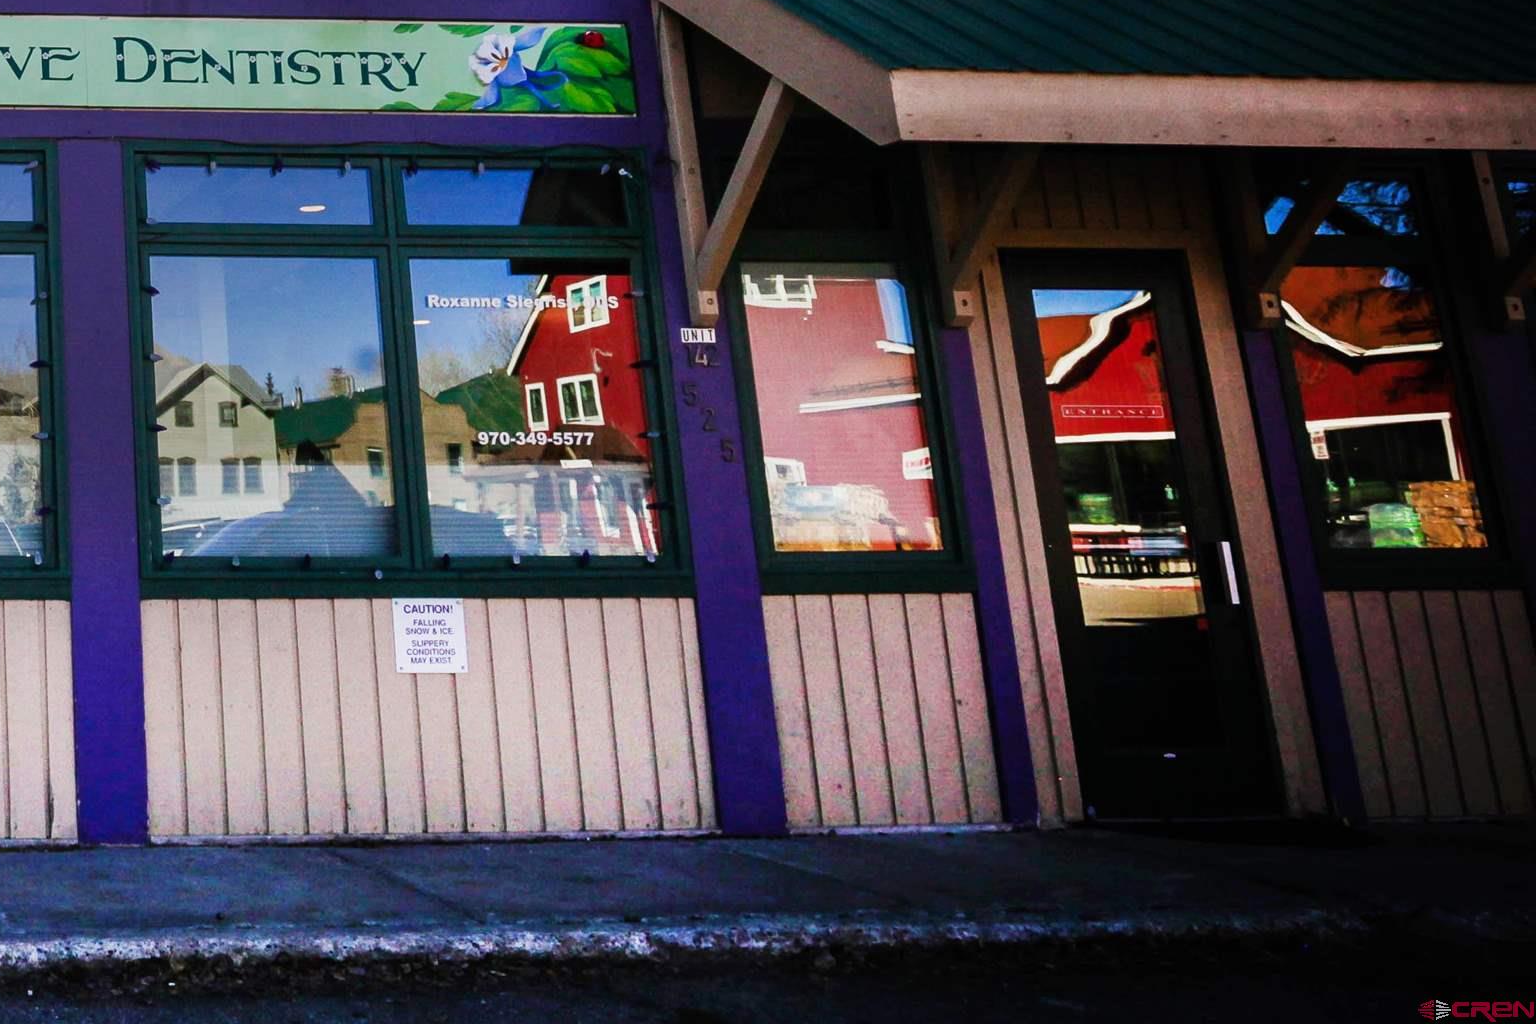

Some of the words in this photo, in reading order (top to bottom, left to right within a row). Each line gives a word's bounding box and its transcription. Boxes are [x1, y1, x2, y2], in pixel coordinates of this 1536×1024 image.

[427, 294, 502, 309] Roxanne
[682, 329, 714, 342] UNIT
[1064, 408, 1160, 416] ENTRANCE
[477, 431, 594, 446] 970-349-5577
[403, 605, 453, 614] CAUTION!
